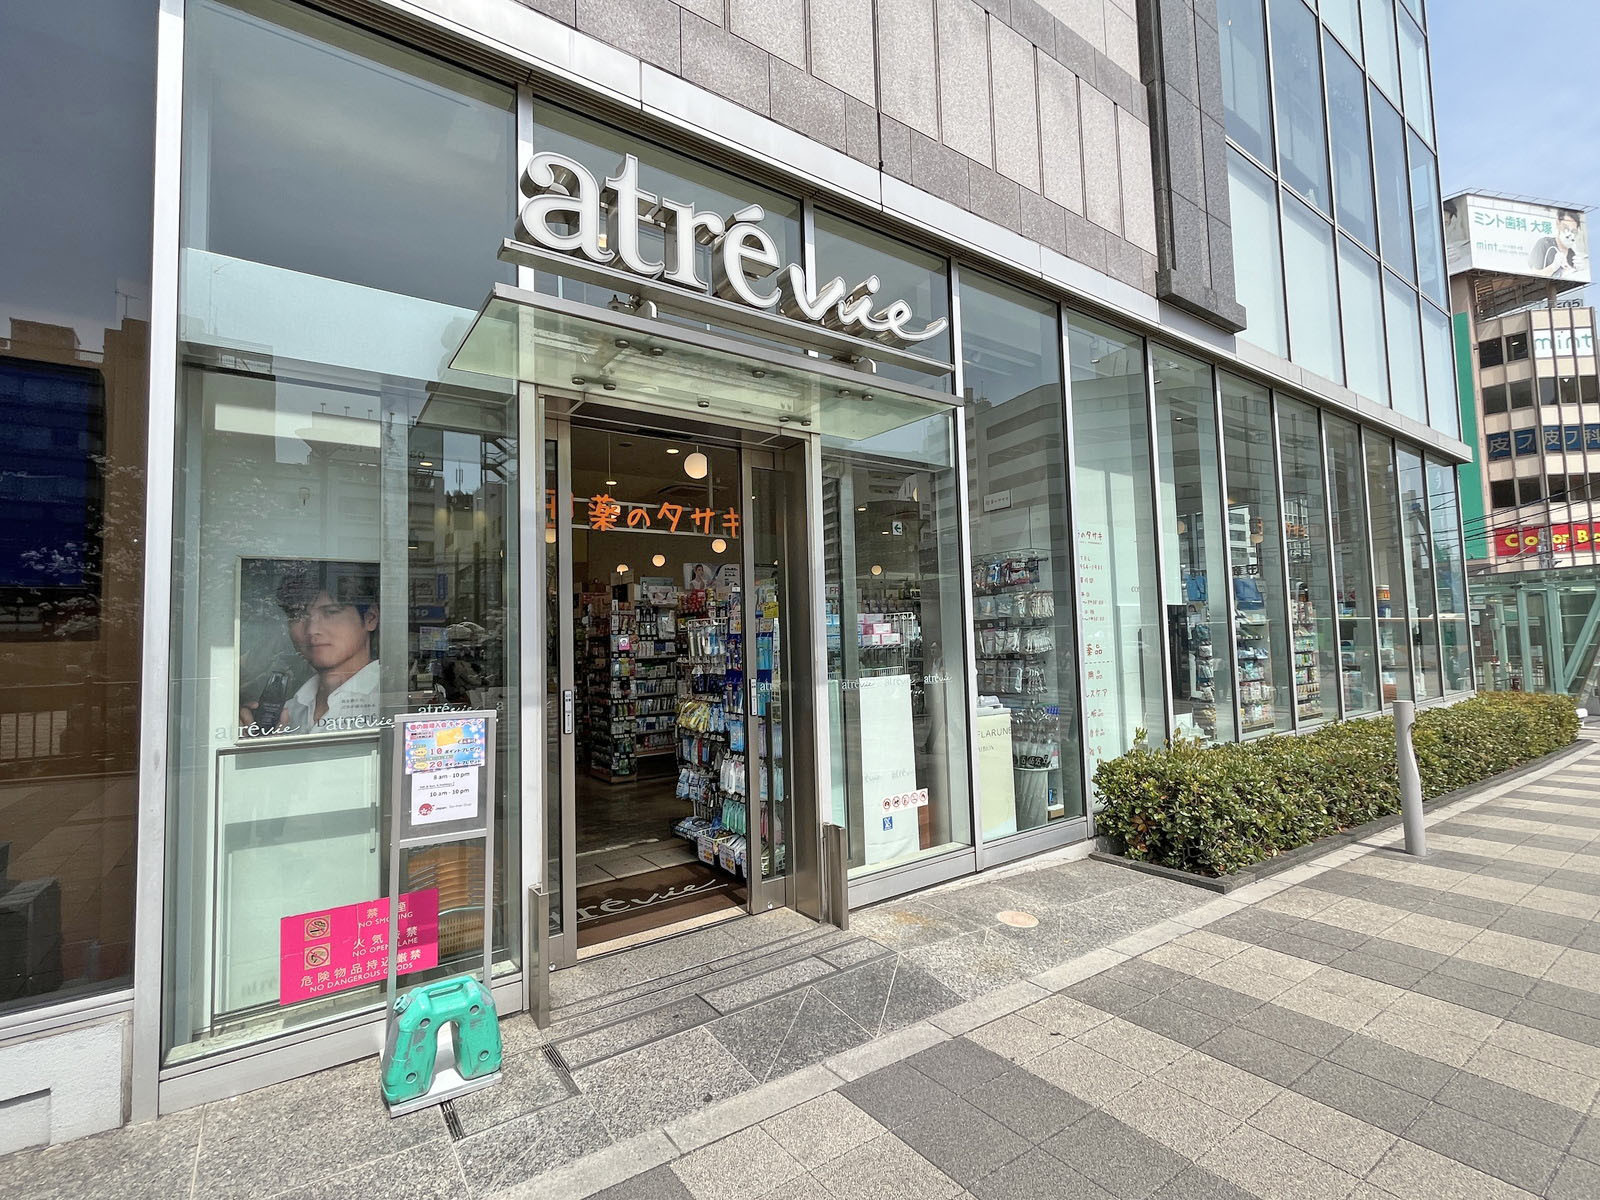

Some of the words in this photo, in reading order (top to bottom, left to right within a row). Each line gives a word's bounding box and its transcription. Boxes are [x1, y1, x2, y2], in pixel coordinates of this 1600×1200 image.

[1474, 211, 1527, 232] ミント歯科
[1530, 219, 1553, 235] 大塚
[514, 151, 949, 340] atrévie
[1476, 240, 1498, 251] mint
[1535, 333, 1592, 350] mint
[588, 494, 740, 538] 薬のタサキ
[1505, 533, 1569, 547] Coor
[359, 920, 372, 928] NO
[375, 912, 413, 924] SMOING
[352, 949, 367, 957] NO
[398, 937, 418, 947] LAME
[353, 925, 418, 949] 火気禁
[309, 984, 325, 993] NO
[327, 970, 381, 988] DANGEROUS
[383, 962, 413, 974] GODS
